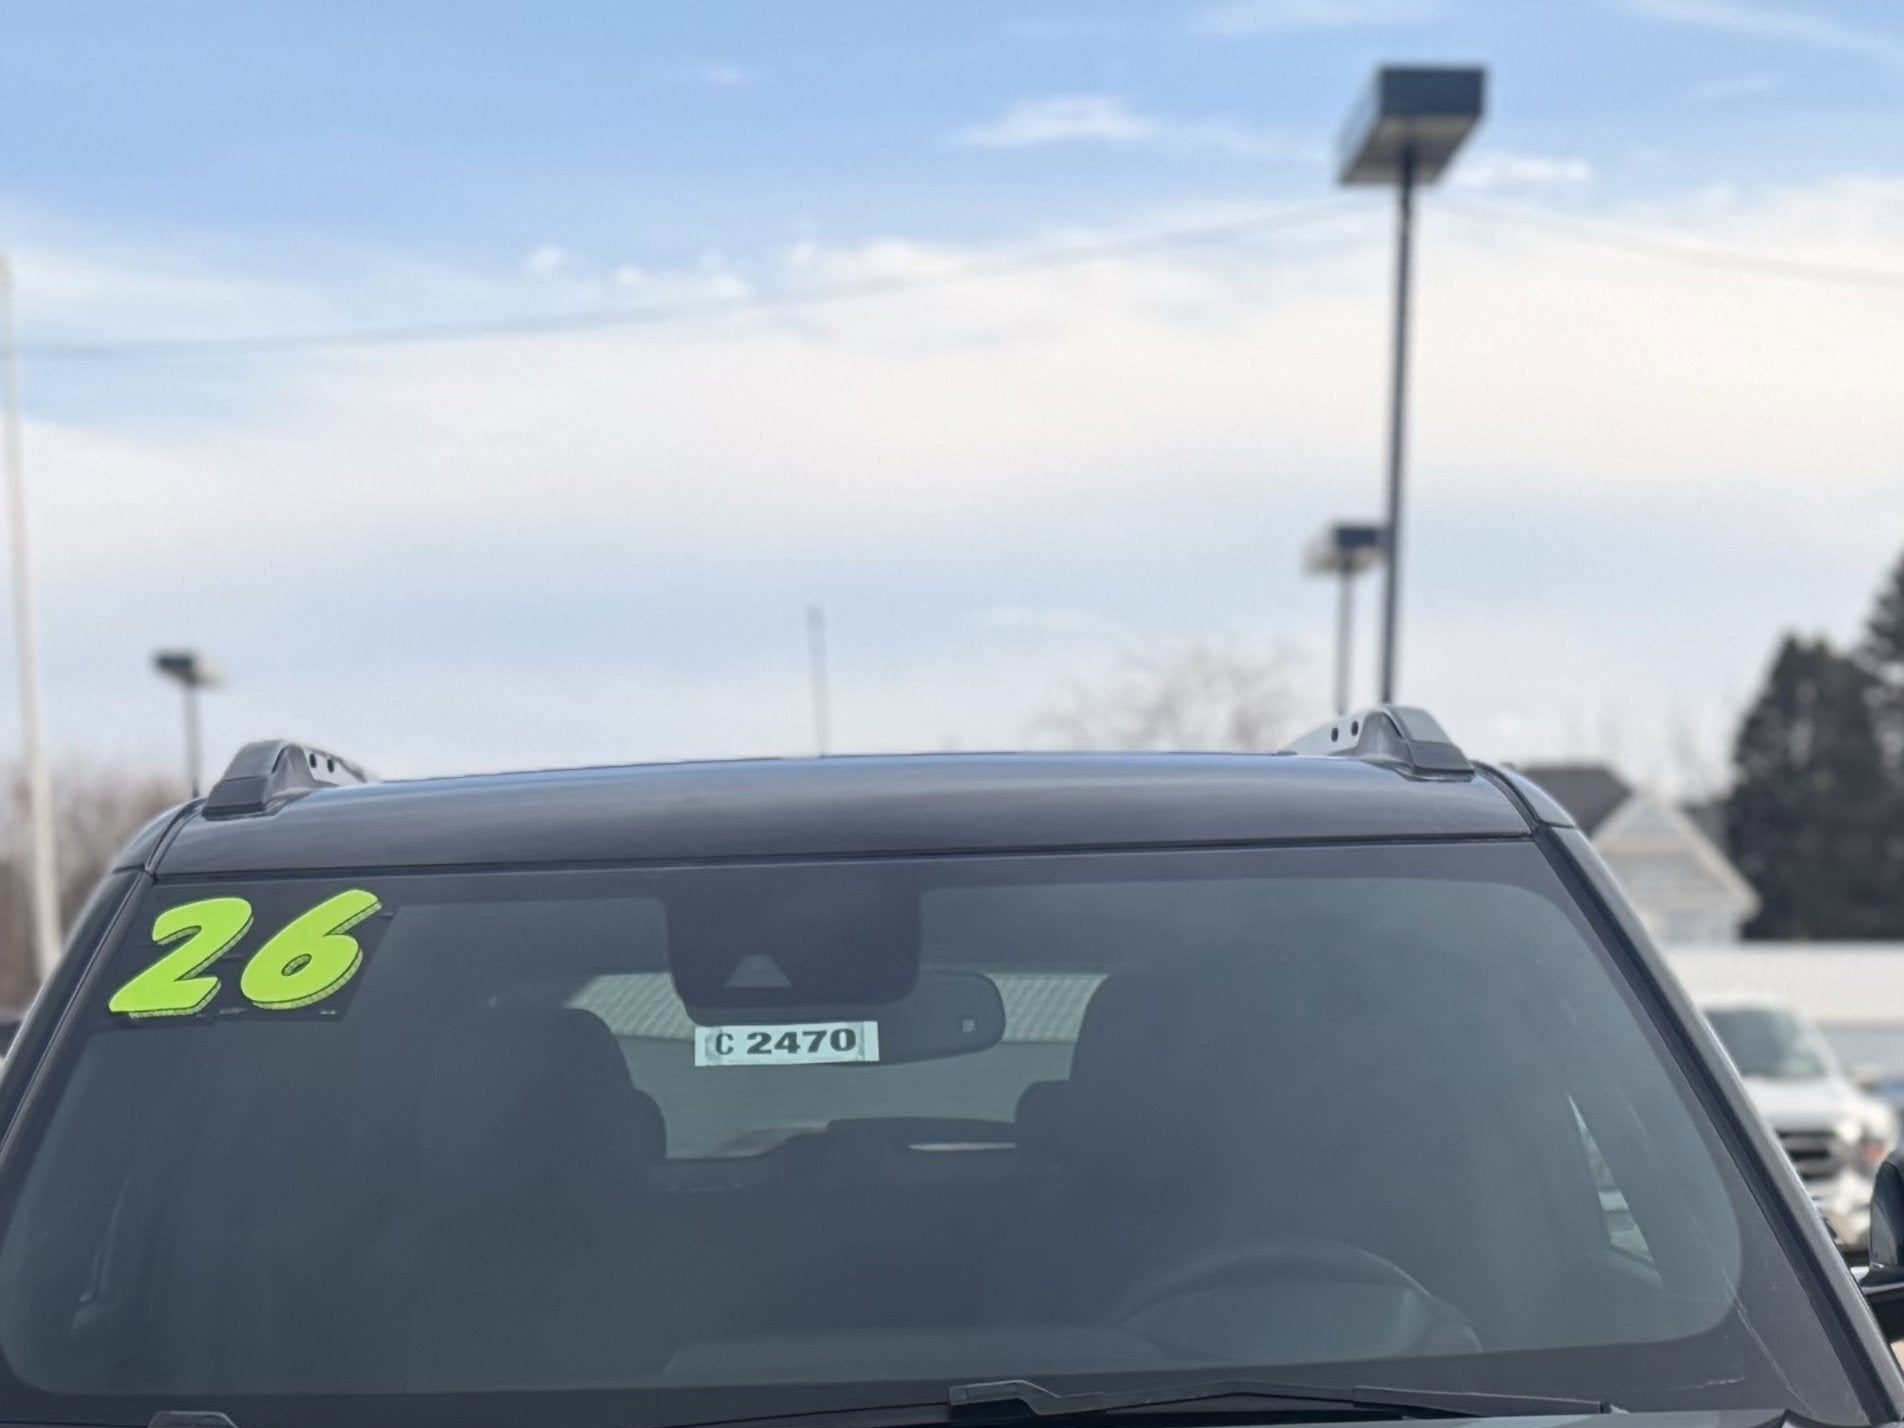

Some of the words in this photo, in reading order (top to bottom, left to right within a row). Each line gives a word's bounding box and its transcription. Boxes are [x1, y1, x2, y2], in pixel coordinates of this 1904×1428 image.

[108, 888, 382, 1018] 26
[715, 1033, 734, 1055] C
[746, 1028, 857, 1055] 2470
